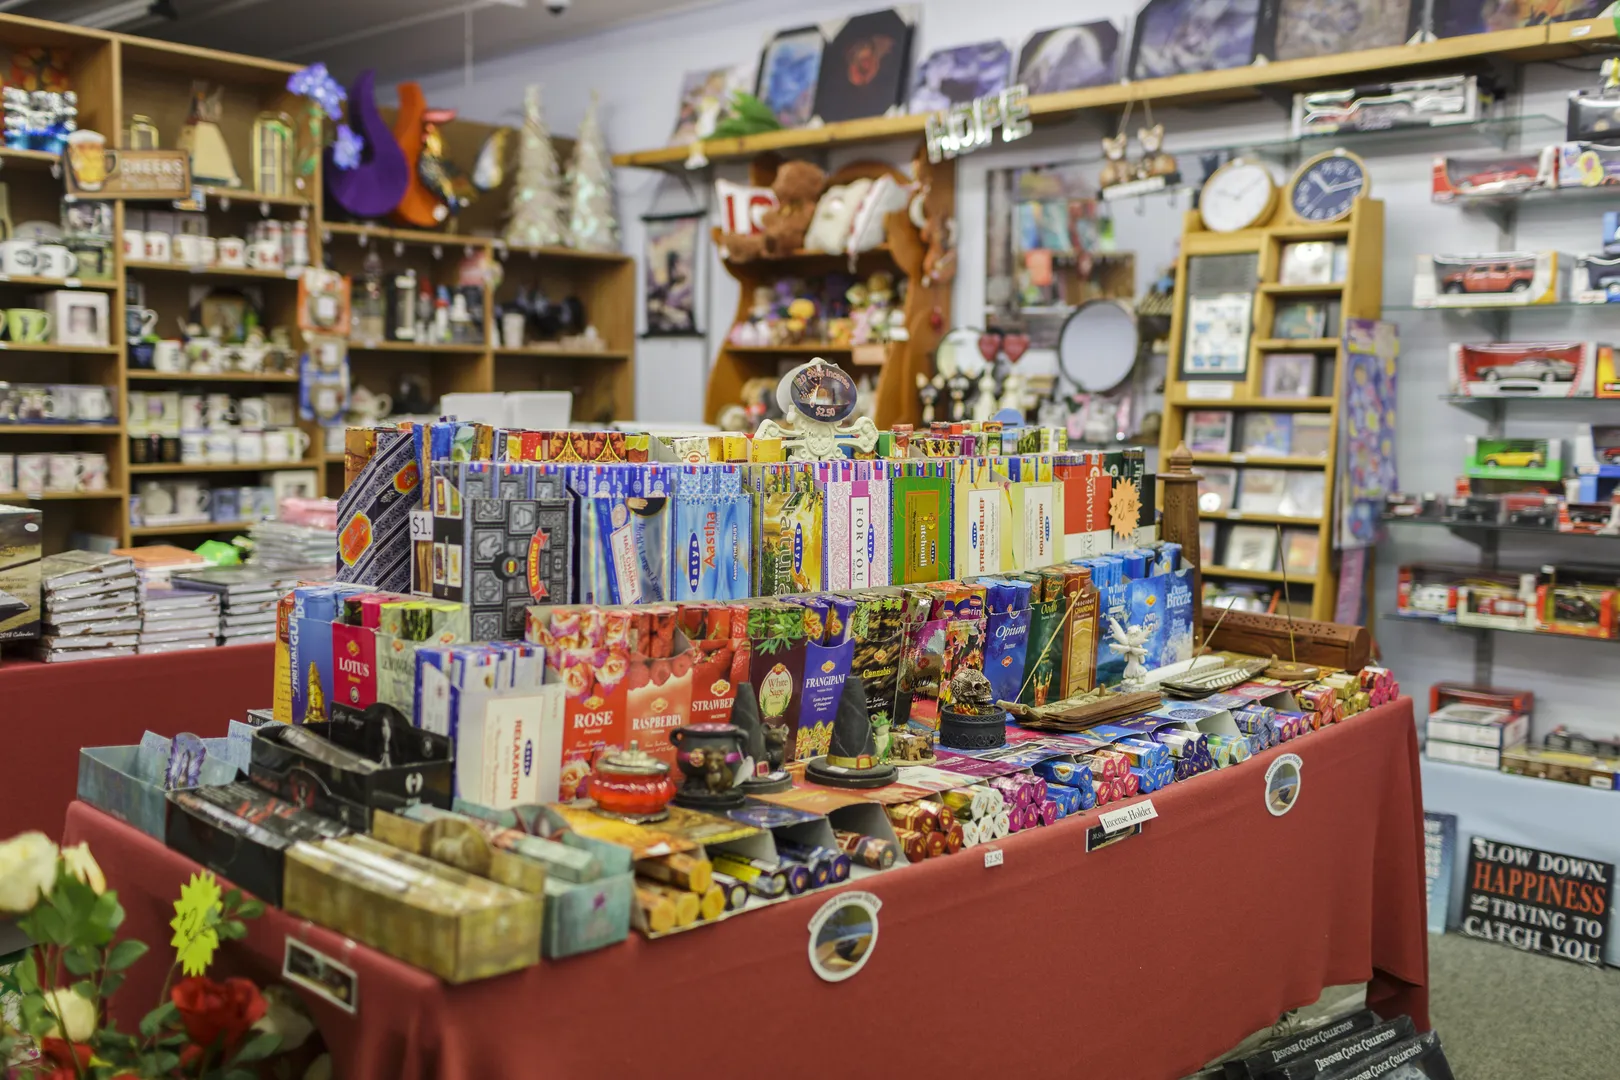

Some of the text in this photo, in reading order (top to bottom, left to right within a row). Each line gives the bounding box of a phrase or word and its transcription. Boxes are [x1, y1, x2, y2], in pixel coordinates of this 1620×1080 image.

[924, 84, 1033, 163] HOPE
[816, 405, 836, 417] $2.50
[704, 511, 716, 569] Aastha
[856, 508, 864, 582] FOR YOU
[690, 540, 699, 586] satya
[1108, 583, 1128, 595] White
[1166, 591, 1192, 609] Breeze
[995, 624, 1027, 641] Opium
[291, 646, 299, 693] SPIRITUAL
[339, 657, 370, 677] LOTUS
[863, 666, 892, 679] Cannabis
[768, 677, 788, 688] White
[769, 687, 784, 698] Sage
[805, 674, 845, 688] FRANGIPANI
[574, 711, 613, 729] ROSE
[632, 714, 682, 730] RASPBERRY
[511, 719, 522, 800] RELAXATION
[1103, 806, 1152, 829] Incense Holder
[1473, 842, 1533, 867] SLOW
[1473, 861, 1606, 916] HAPPINESS
[1470, 893, 1603, 939] IS TRYING TO
[1463, 915, 1601, 964] CATCH YOU
[1272, 1020, 1354, 1063] DESIGNER CLOCK COLLECTION
[1314, 1028, 1397, 1072] DESIGNER CLOCK COLLECTION
[1370, 1061, 1390, 1077] CLOCK
[1389, 1042, 1424, 1067] COLLECTION
